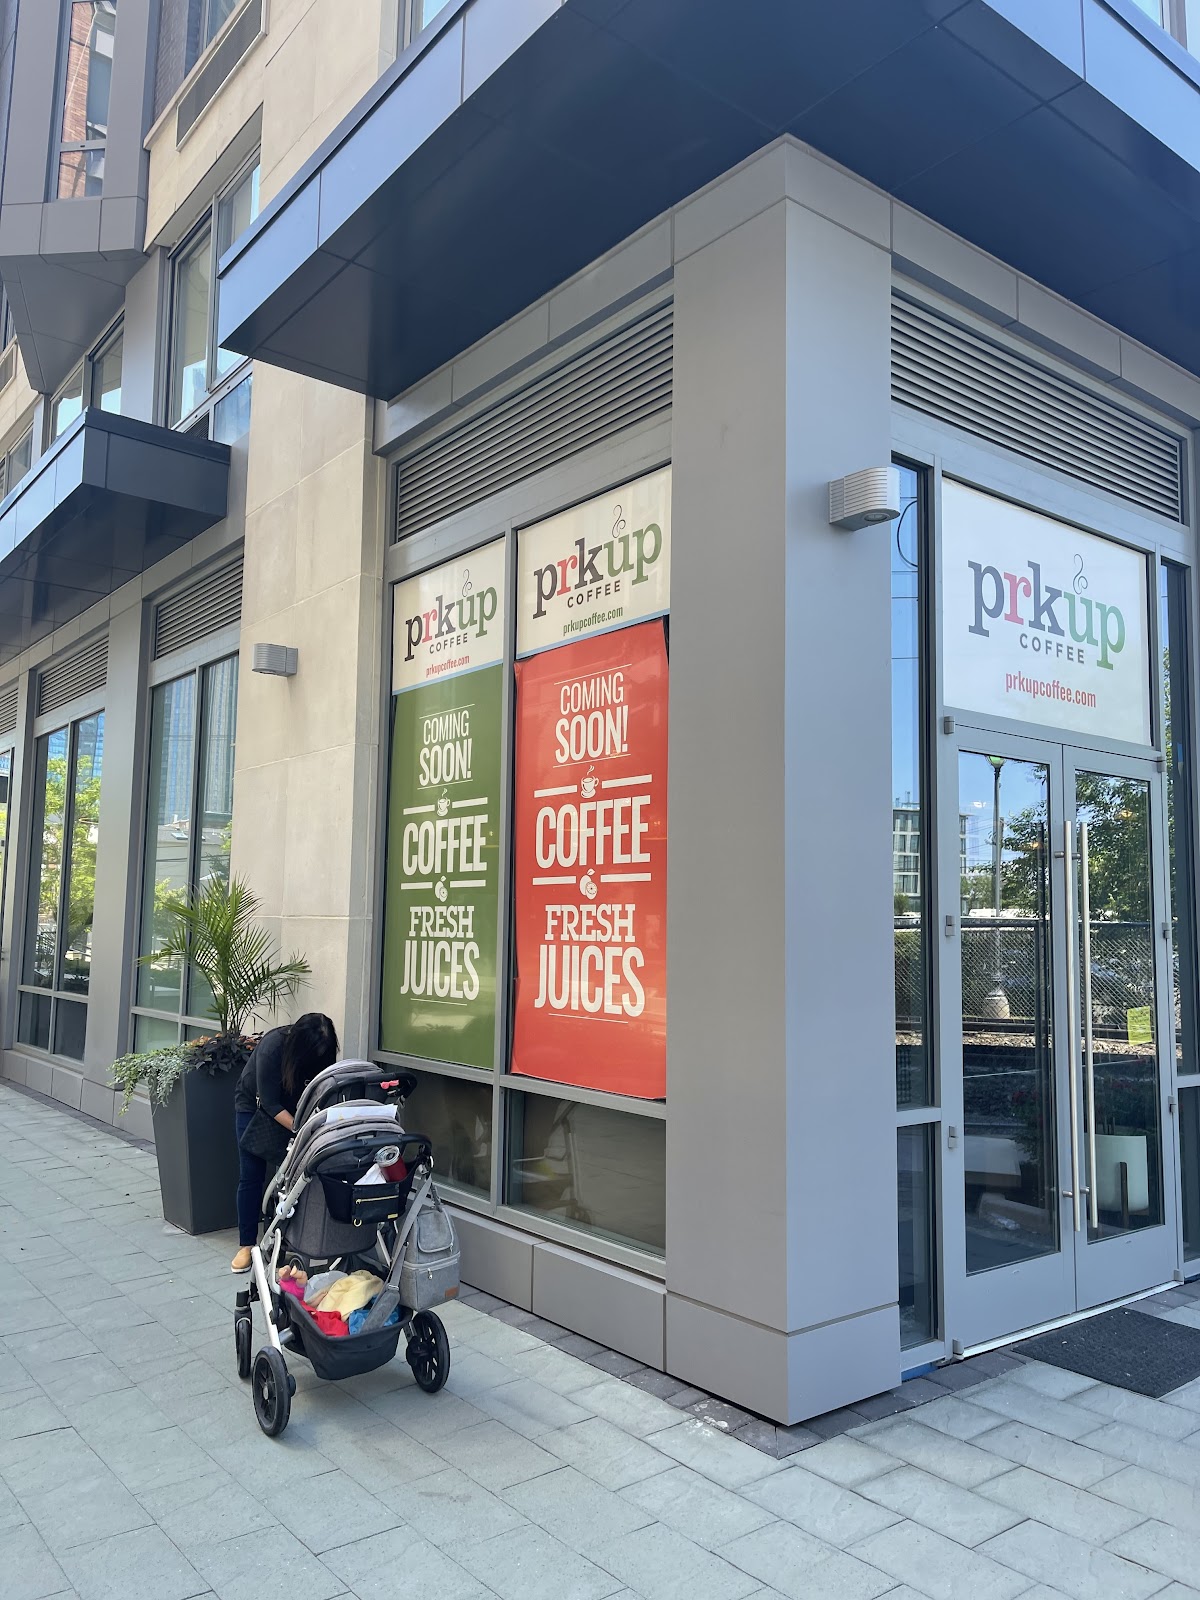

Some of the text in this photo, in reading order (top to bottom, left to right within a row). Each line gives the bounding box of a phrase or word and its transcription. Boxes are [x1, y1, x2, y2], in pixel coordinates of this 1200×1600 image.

[533, 522, 662, 619] prkup
[567, 580, 621, 608] COFFEE
[968, 560, 1126, 670] prkup
[405, 586, 498, 661] prkup
[429, 632, 468, 654] COFFEE
[563, 606, 623, 636] prkupcoffee.com
[426, 654, 470, 678] prkupcoffee.com
[1019, 633, 1085, 664] COFFEE
[560, 672, 624, 716] COMING
[1005, 671, 1096, 708] prkupcoffee.com
[423, 710, 469, 745] COMING
[555, 705, 629, 764] SOON!
[419, 738, 472, 786] SOON!
[402, 814, 489, 876] COFFEE
[535, 795, 651, 869] COFFEE
[409, 905, 475, 939] FRESH
[544, 903, 636, 943] FRESH
[400, 940, 480, 1001] JUICES
[534, 944, 646, 1018] JUICES
